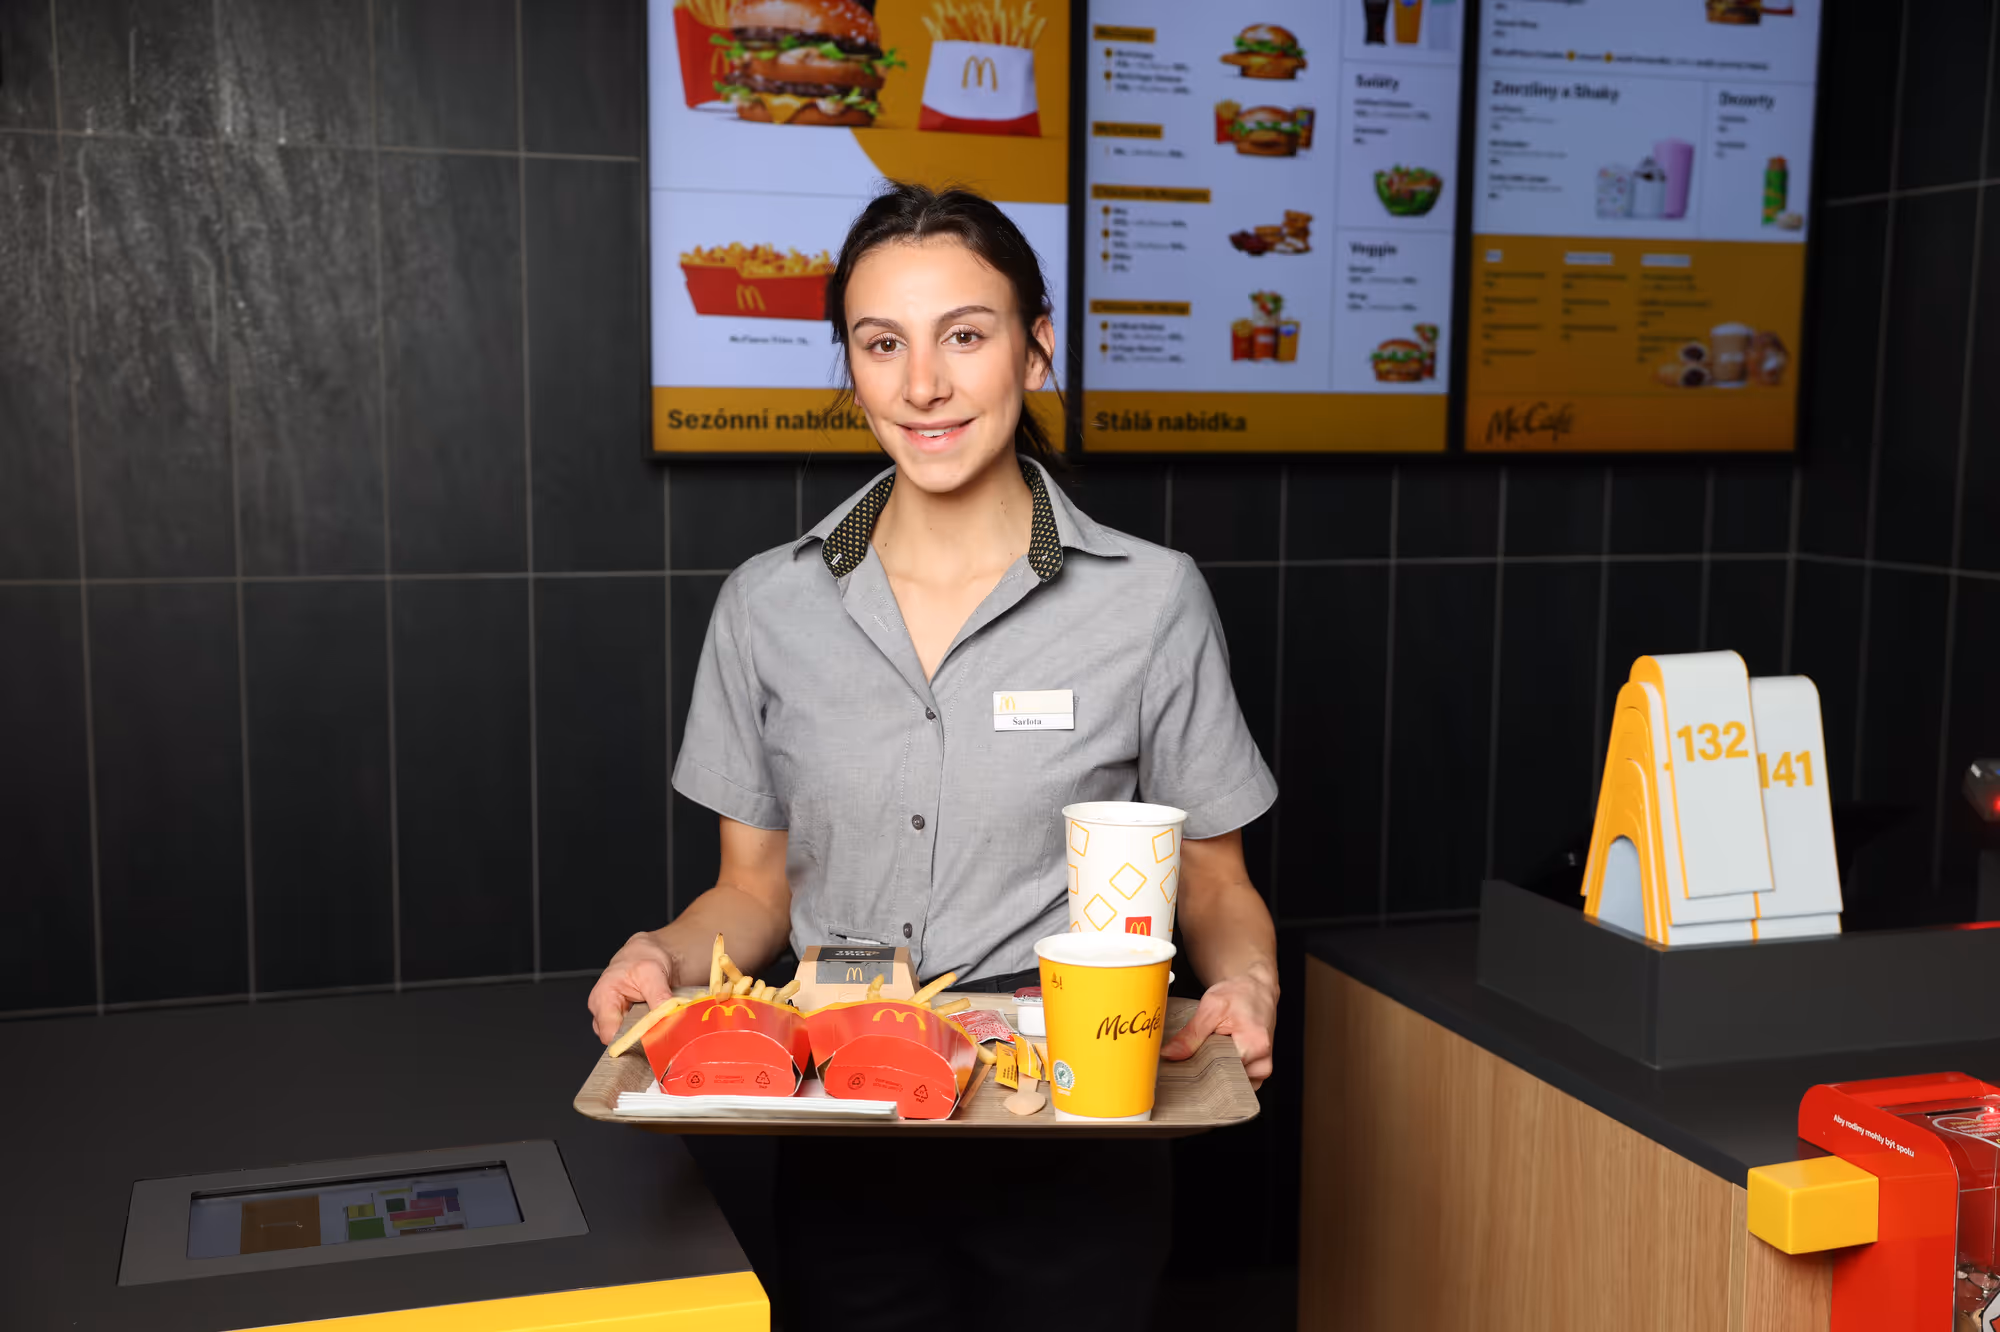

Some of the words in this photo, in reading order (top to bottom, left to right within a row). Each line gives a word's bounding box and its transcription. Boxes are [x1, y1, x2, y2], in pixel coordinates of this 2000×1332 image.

[668, 407, 769, 431] Sezónní
[1095, 411, 1153, 433] Stálá
[1158, 411, 1246, 432] nabídka
[1012, 717, 1042, 726] Šarlota
[1677, 721, 1749, 762] 132
[1758, 750, 1814, 789] 141
[1096, 1006, 1161, 1041] McCafé
[1833, 1114, 1846, 1127] Aby
[1845, 1120, 1865, 1136] rodiny
[1865, 1130, 1885, 1145] mohly
[1884, 1137, 1896, 1149] být
[1896, 1144, 1915, 1158] spolu
